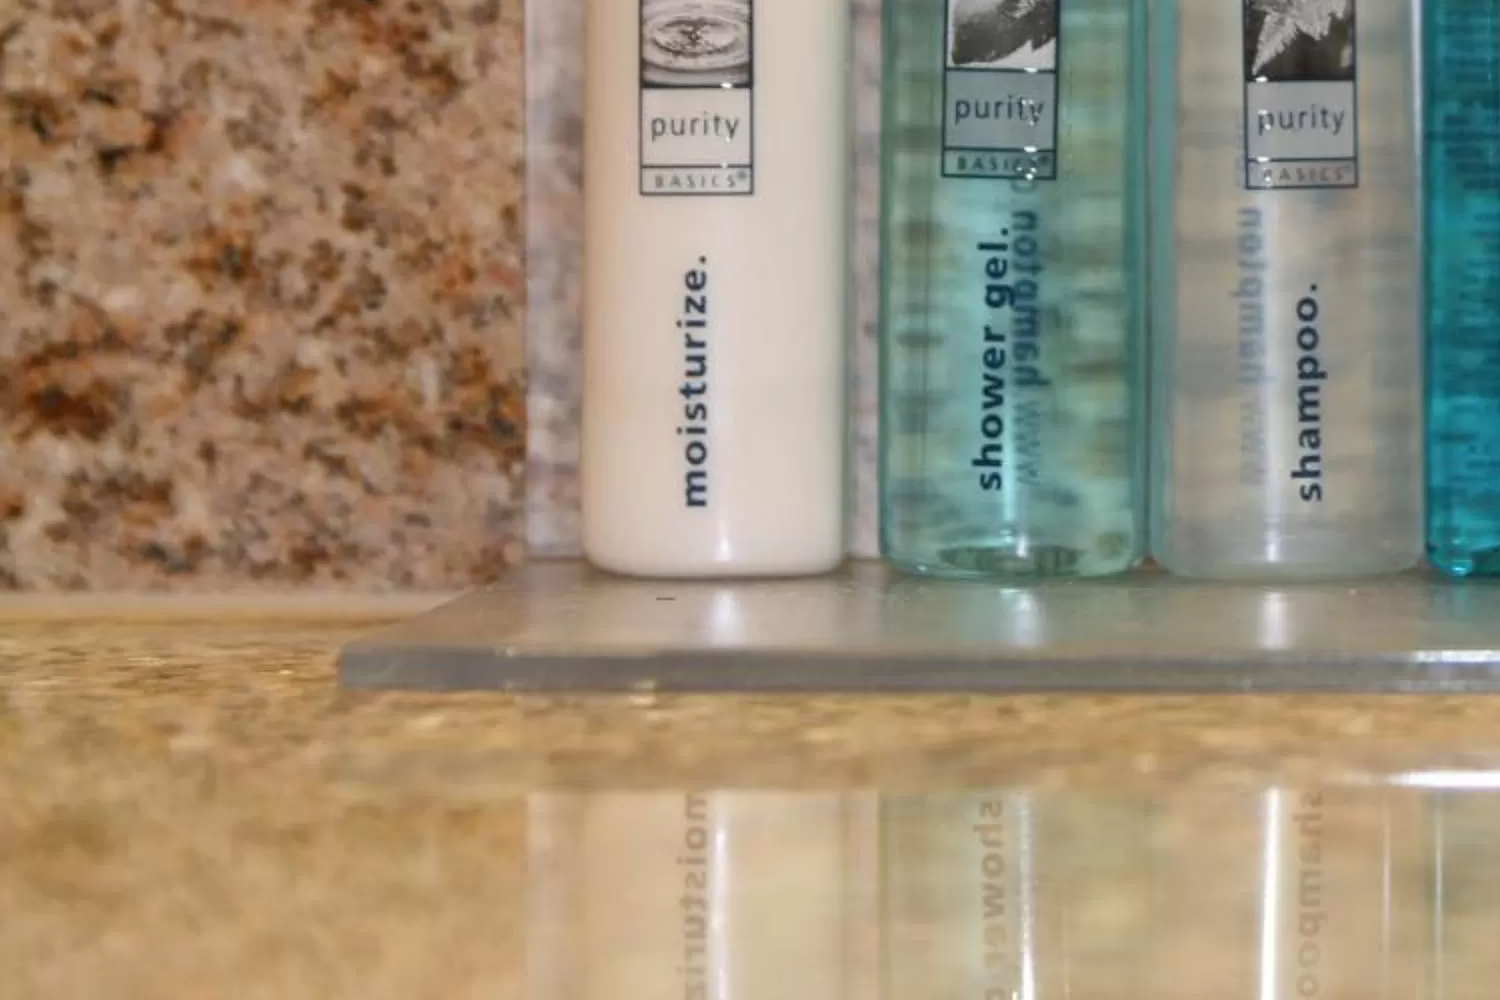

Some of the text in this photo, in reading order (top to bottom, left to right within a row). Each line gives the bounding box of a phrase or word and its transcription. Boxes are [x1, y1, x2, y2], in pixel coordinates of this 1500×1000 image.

[651, 111, 741, 142] purity
[955, 94, 1045, 126] purity
[1258, 104, 1345, 136] purity
[676, 255, 708, 508] moisturize.
[972, 226, 1016, 491] shower gel.
[1291, 283, 1329, 502] shampoo.
